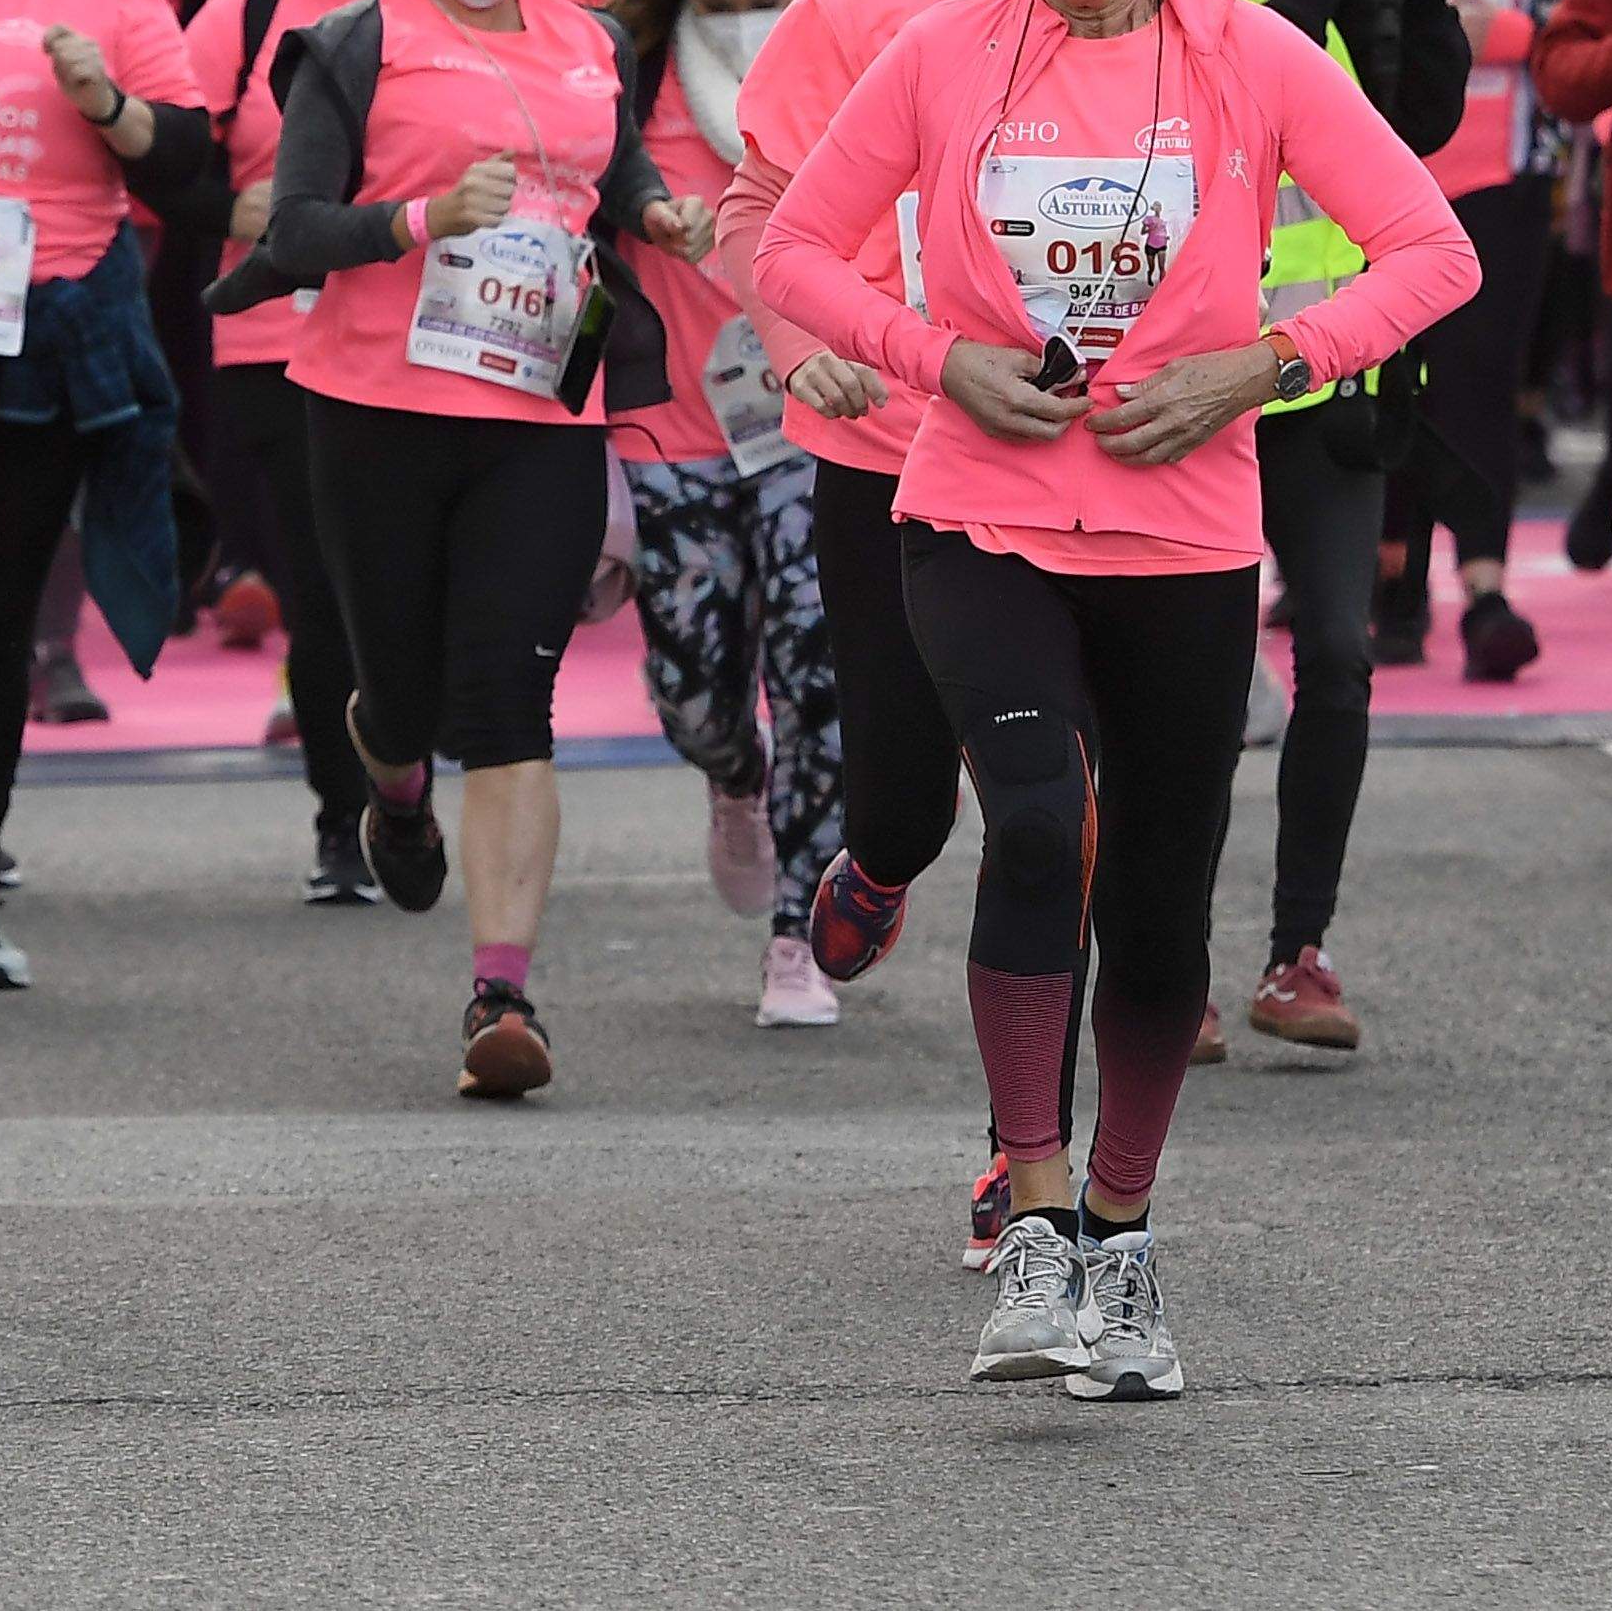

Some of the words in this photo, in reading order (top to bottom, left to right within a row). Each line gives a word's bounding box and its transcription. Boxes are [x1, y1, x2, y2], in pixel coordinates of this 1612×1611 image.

[1142, 131, 1192, 150] ASTURI
[1046, 194, 1140, 217] ASTURIANA
[1046, 239, 1141, 277] 016
[479, 276, 542, 318] 016
[1114, 303, 1130, 318] DE
[1131, 301, 1147, 315] BA
[994, 709, 1039, 724] TARMAK
